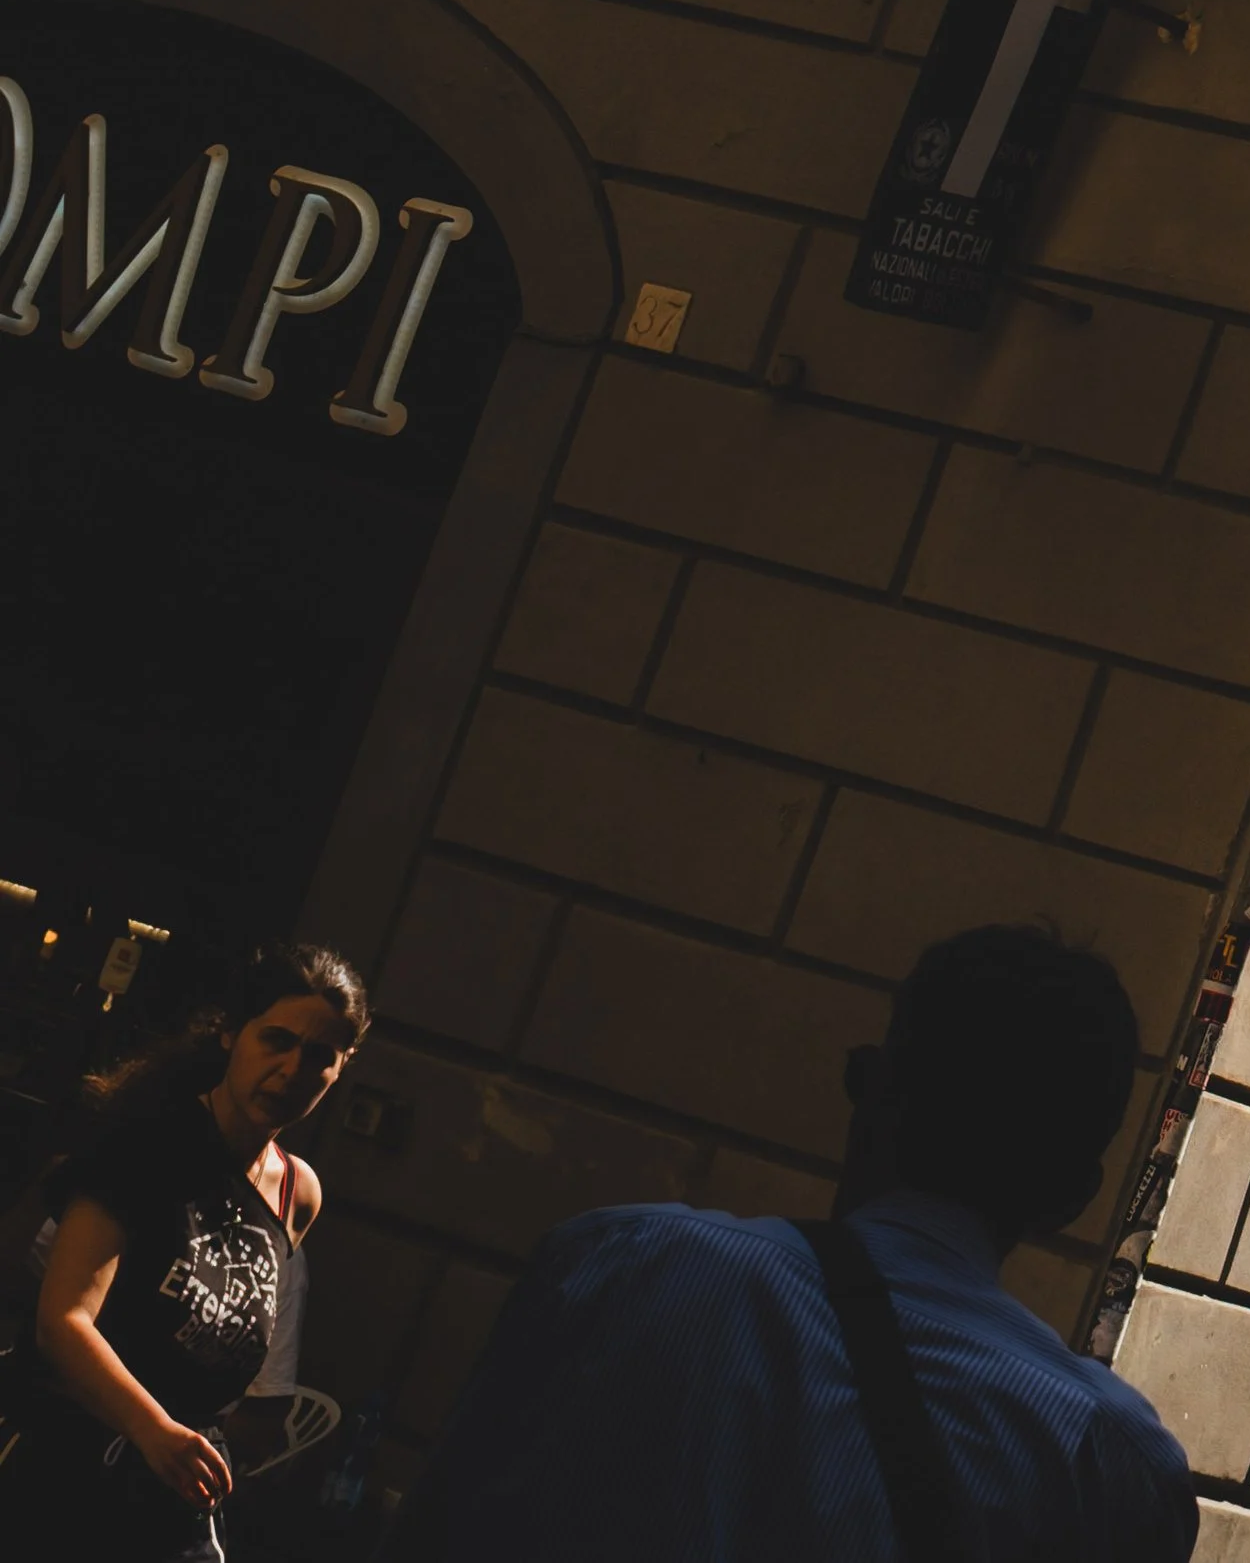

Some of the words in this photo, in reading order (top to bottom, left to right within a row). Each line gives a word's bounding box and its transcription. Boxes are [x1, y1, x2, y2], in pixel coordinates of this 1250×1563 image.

[919, 197, 961, 222] SALI
[965, 207, 981, 226] E
[890, 216, 995, 266] TABACCHI
[869, 249, 938, 282] NAZIONALI
[632, 294, 684, 338] 37
